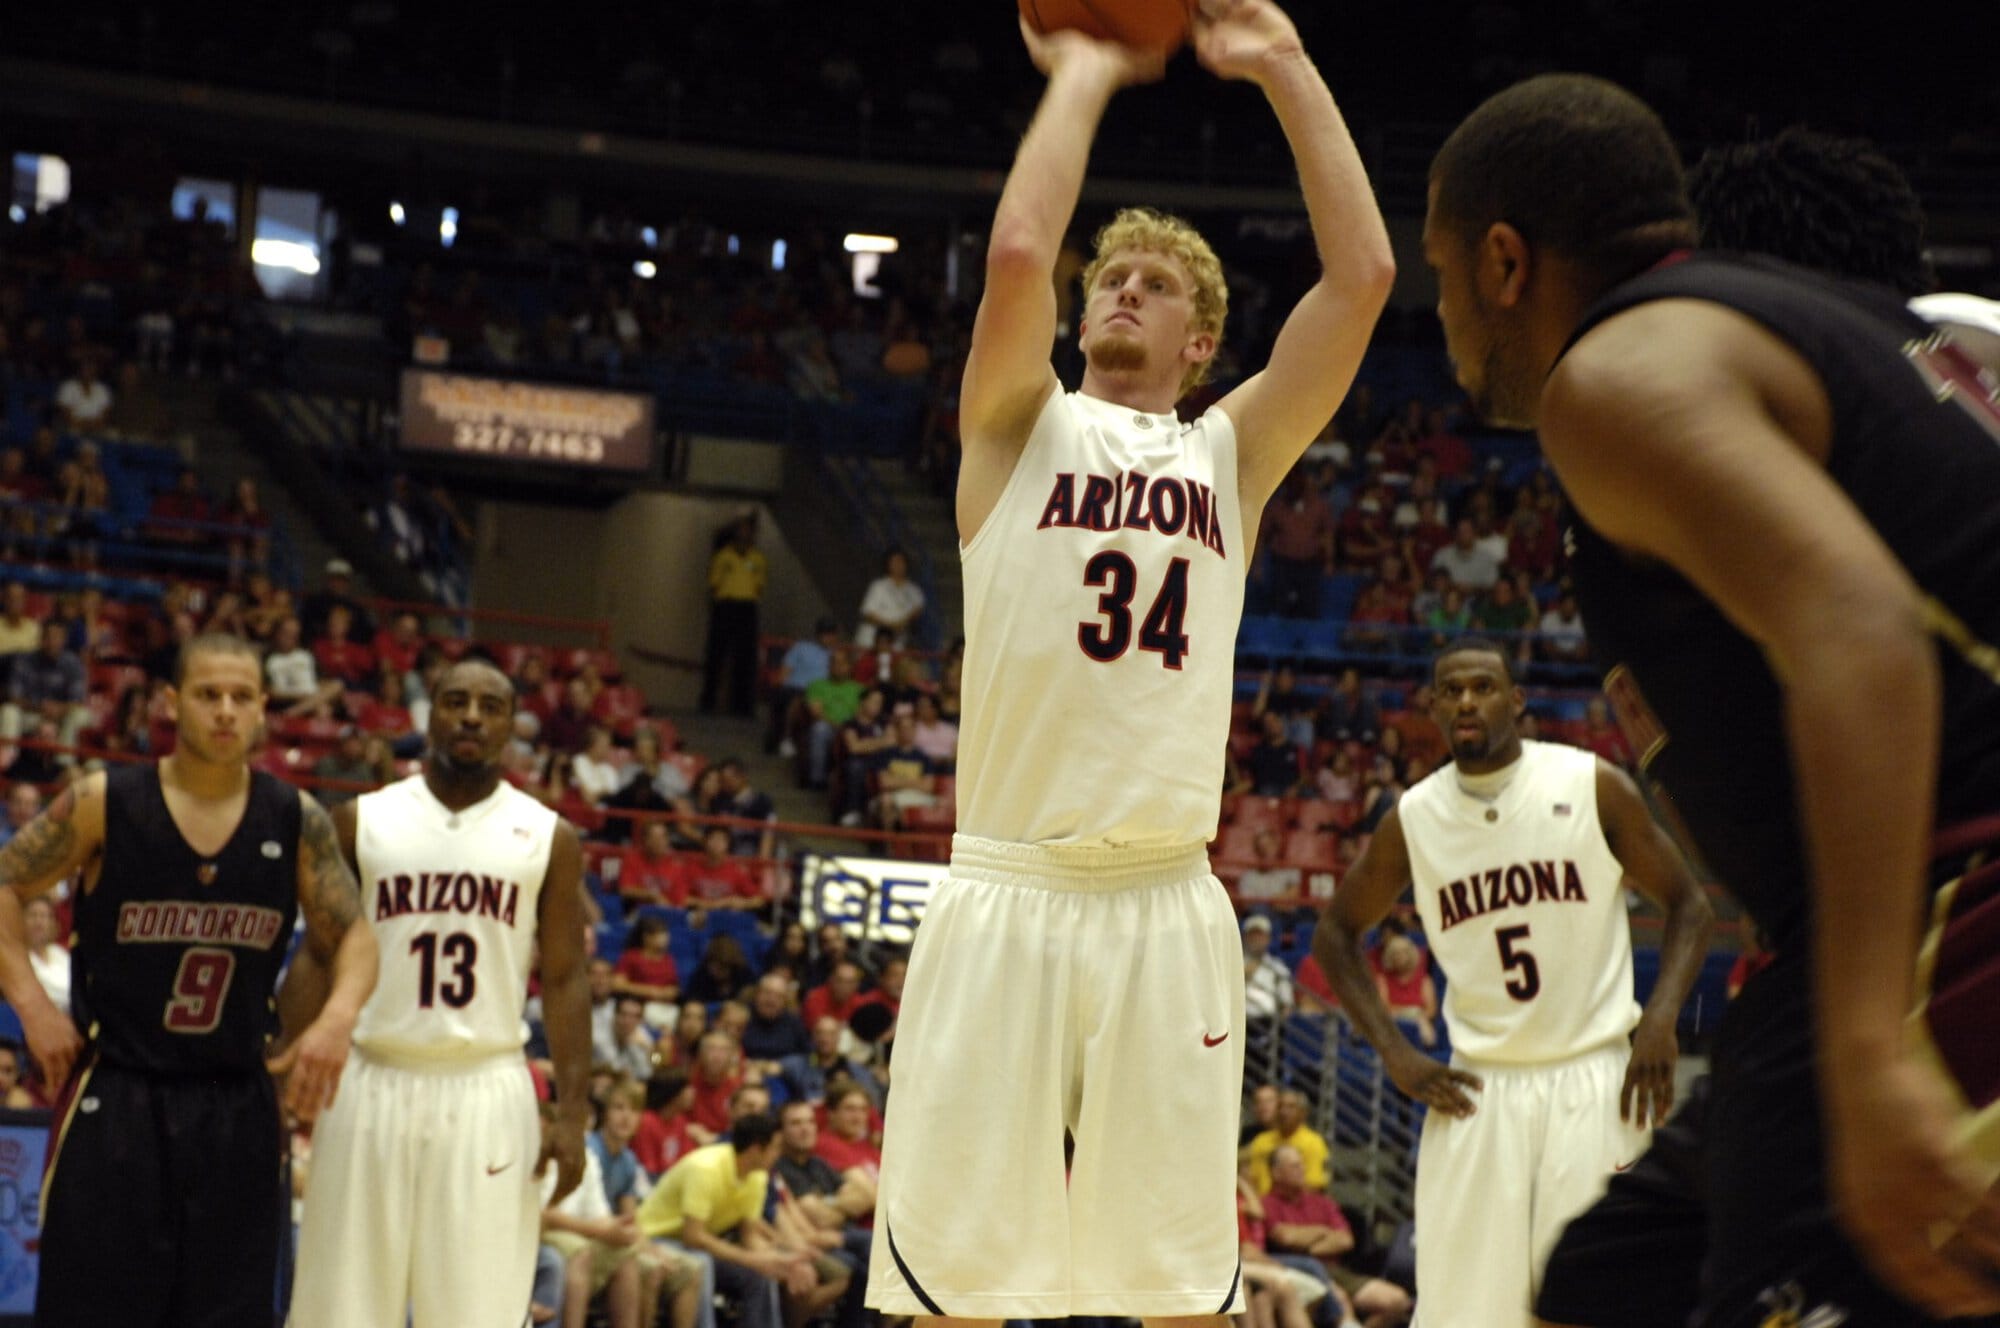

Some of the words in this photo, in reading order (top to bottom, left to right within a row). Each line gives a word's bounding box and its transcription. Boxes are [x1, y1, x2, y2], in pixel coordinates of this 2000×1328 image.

[1036, 470, 1226, 560] ARIZONA
[1077, 549, 1191, 671] 34
[116, 900, 284, 950] CONCORDIA
[375, 871, 520, 930] ARIZONA
[1437, 857, 1589, 933] ARIZONA
[163, 946, 236, 1034] 9
[409, 931, 478, 1011] 13
[1494, 922, 1541, 1004] 5
